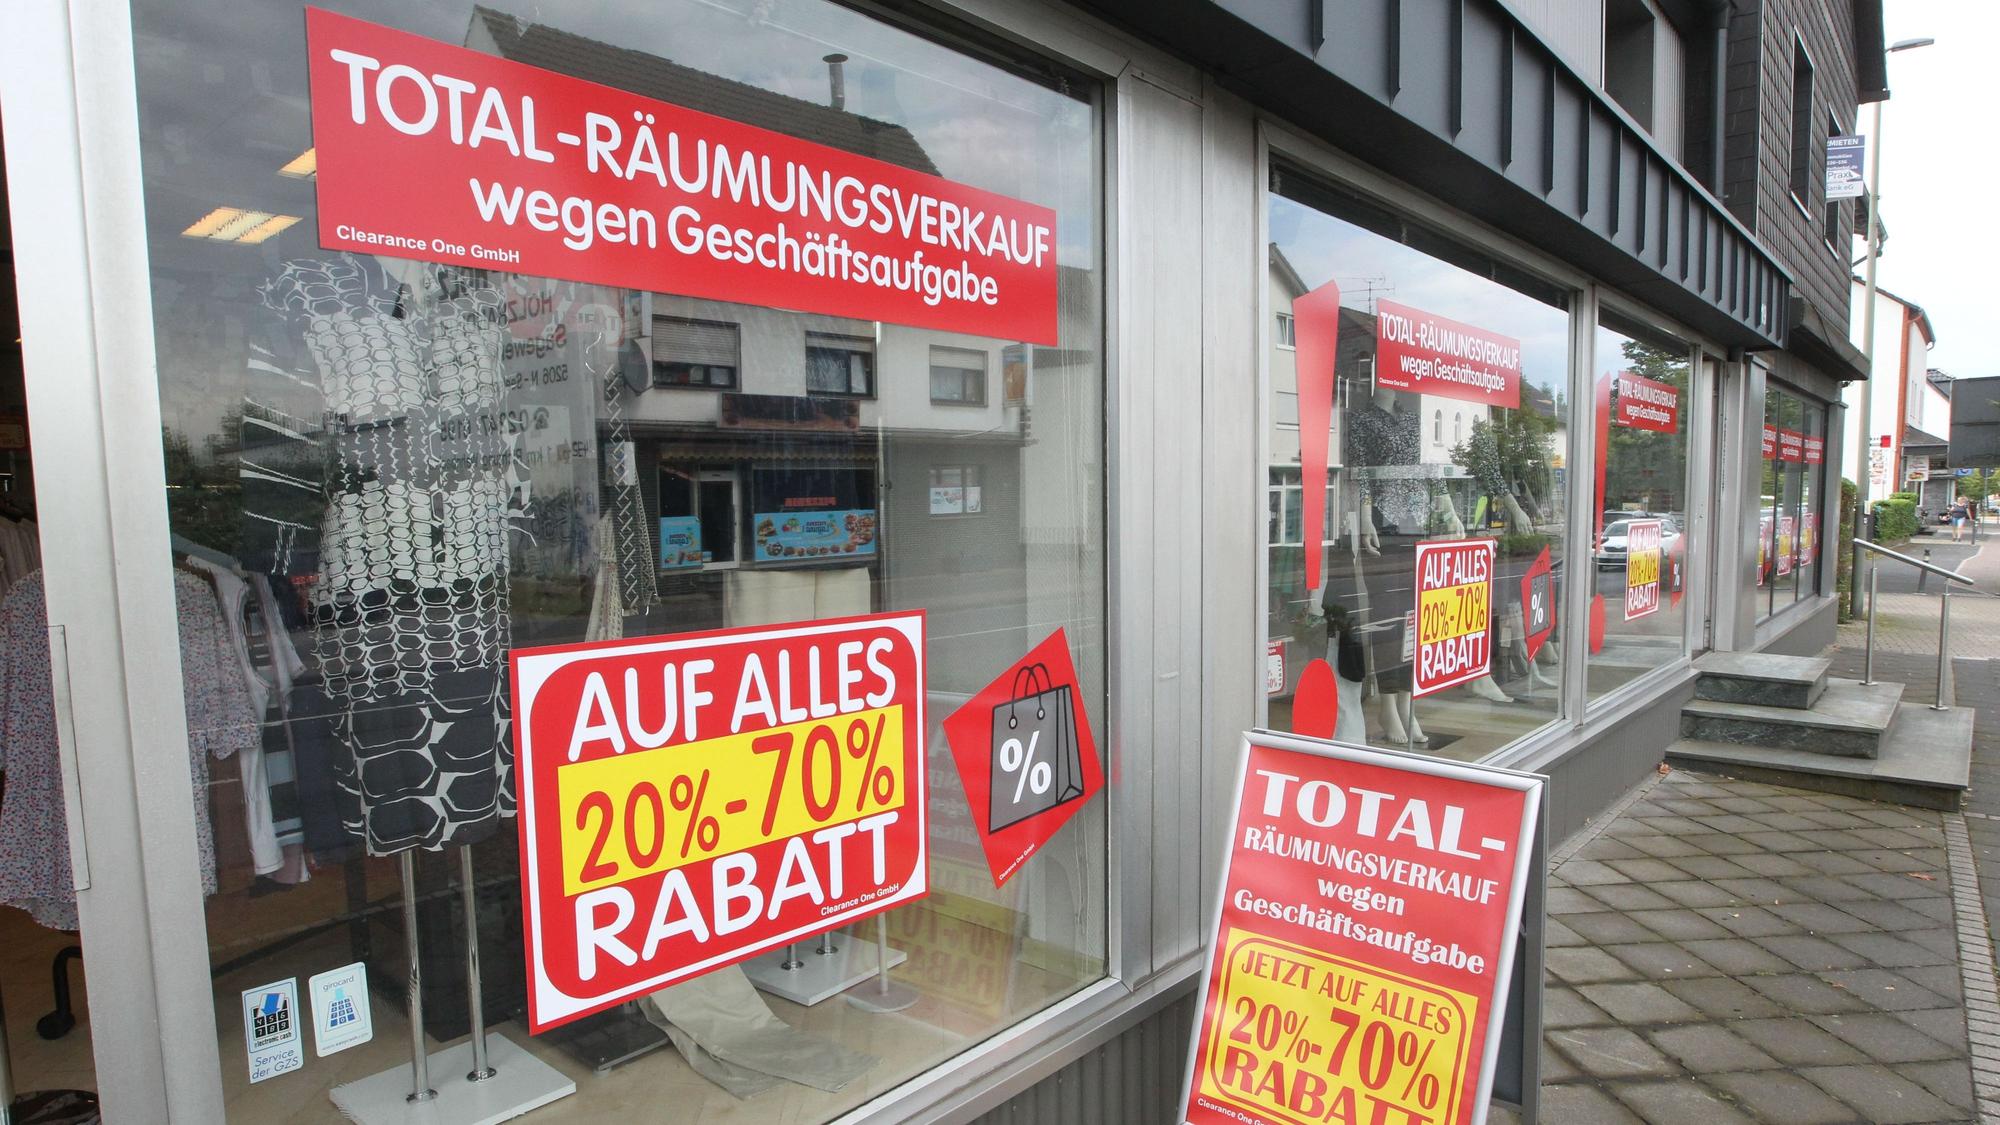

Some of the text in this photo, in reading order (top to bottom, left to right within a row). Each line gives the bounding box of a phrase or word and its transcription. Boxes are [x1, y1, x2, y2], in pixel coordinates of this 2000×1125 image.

[330, 48, 1050, 268] TOTAL-RÄUMUNGSVERKAUF
[336, 224, 521, 264] Clearance One GmbH
[469, 177, 998, 306] wegen Geschäftsaufgabe
[1380, 311, 1519, 371] TOTAL-RÄUMUNGSVERKAUF
[1400, 354, 1505, 393] wegen Geschäftsaufgabe
[1423, 548, 1487, 590] AUF ALLES
[1423, 584, 1485, 642] 20%-70%
[1531, 591, 1543, 626] %
[1628, 582, 1657, 612] RABATT
[1421, 631, 1485, 682] RABATT
[567, 637, 897, 762] AUF ALLES
[999, 730, 1052, 804] %
[576, 713, 895, 884] 20%-70%
[1255, 769, 1506, 861] TOTAL-
[1243, 824, 1499, 905] RÄUMUNGSVERKAUF
[574, 810, 899, 982] RABATT
[821, 882, 900, 916] Clearance One GmbH
[1317, 878, 1405, 916] wegen
[1233, 889, 1485, 975] Geschäftsaufgabe
[322, 975, 355, 993] girocard
[1241, 950, 1452, 1035] JETZT AUF ALLES
[255, 1031, 292, 1049] electronic cash
[255, 1049, 294, 1068] Service
[1229, 996, 1440, 1110] 20%-70%
[252, 1056, 299, 1080] der GZS
[1197, 1097, 1237, 1118] Clearance
[1236, 1112, 1254, 1125] One
